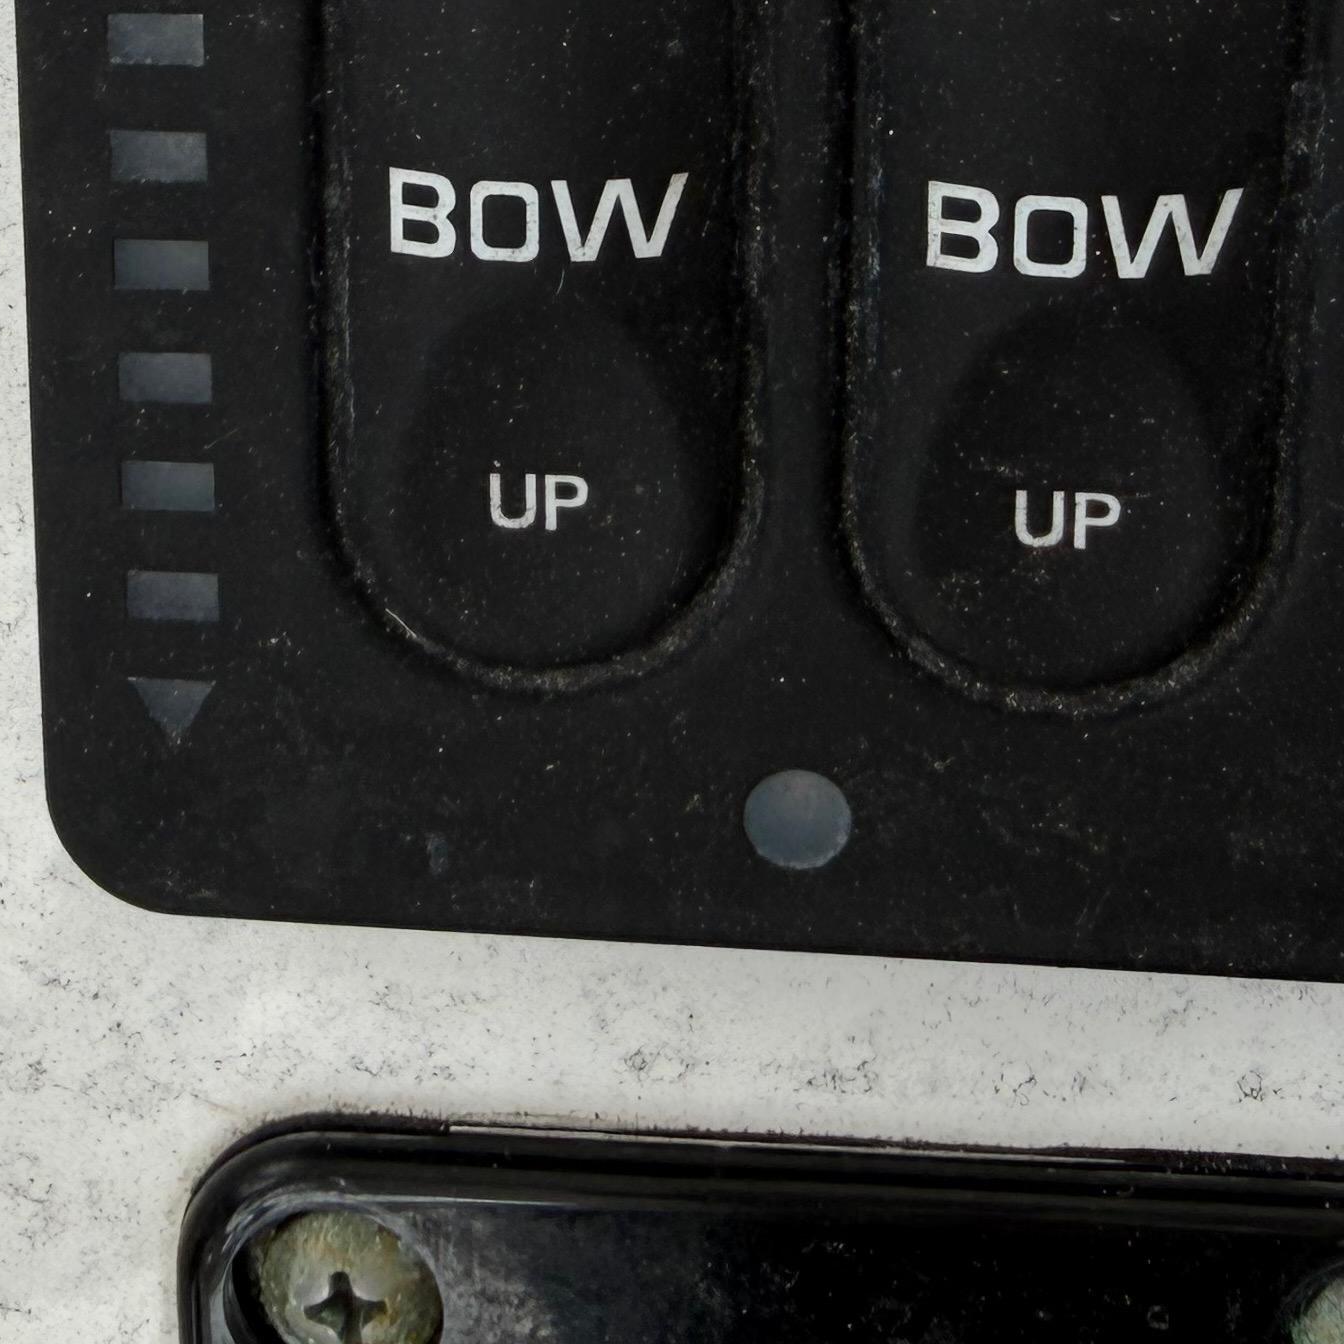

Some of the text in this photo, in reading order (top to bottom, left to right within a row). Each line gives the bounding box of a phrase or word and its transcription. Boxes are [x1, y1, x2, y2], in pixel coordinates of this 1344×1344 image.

[388, 166, 689, 263] BOW
[926, 180, 1244, 279] BOW
[489, 473, 589, 531] UP
[1014, 489, 1122, 550] UP
